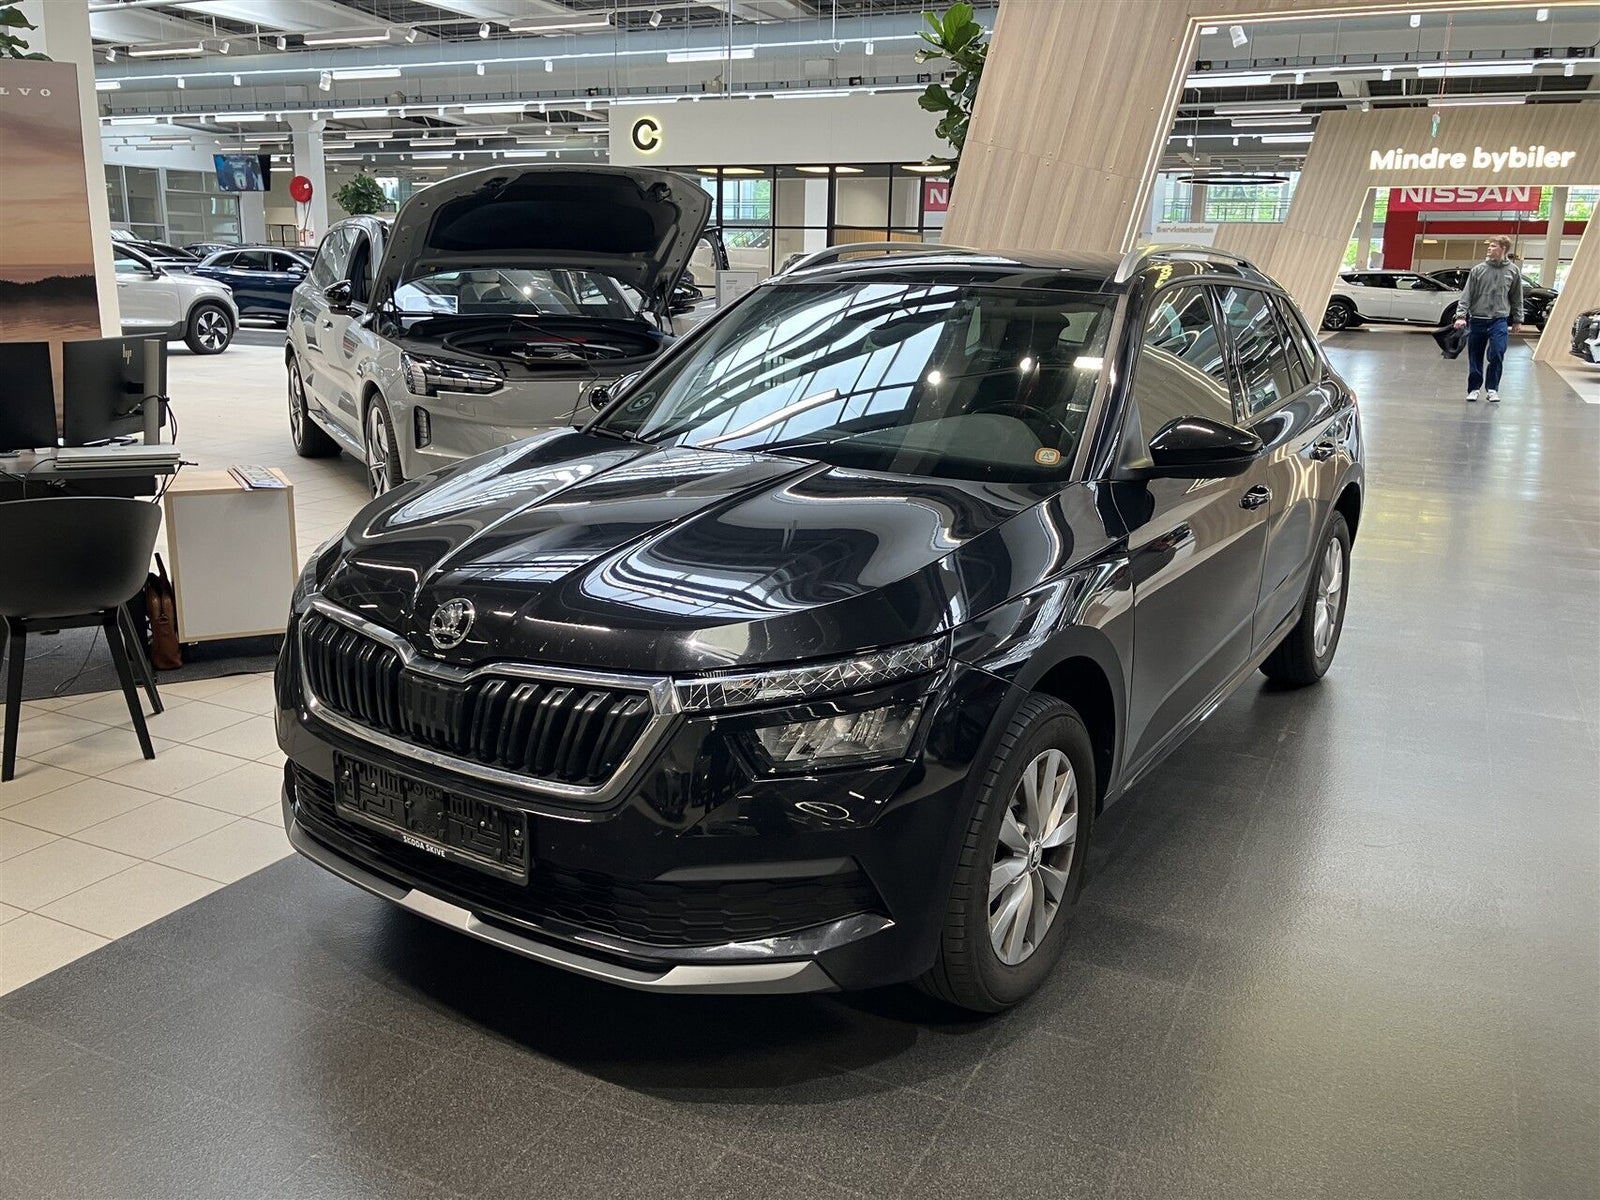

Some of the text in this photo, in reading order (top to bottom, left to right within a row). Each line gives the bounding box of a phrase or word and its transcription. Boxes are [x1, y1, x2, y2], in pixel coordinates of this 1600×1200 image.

[632, 118, 659, 151] C
[1369, 146, 1576, 173] Mindre bybiler
[1400, 187, 1531, 203] NISSAN
[425, 844, 446, 858] SKIVE
